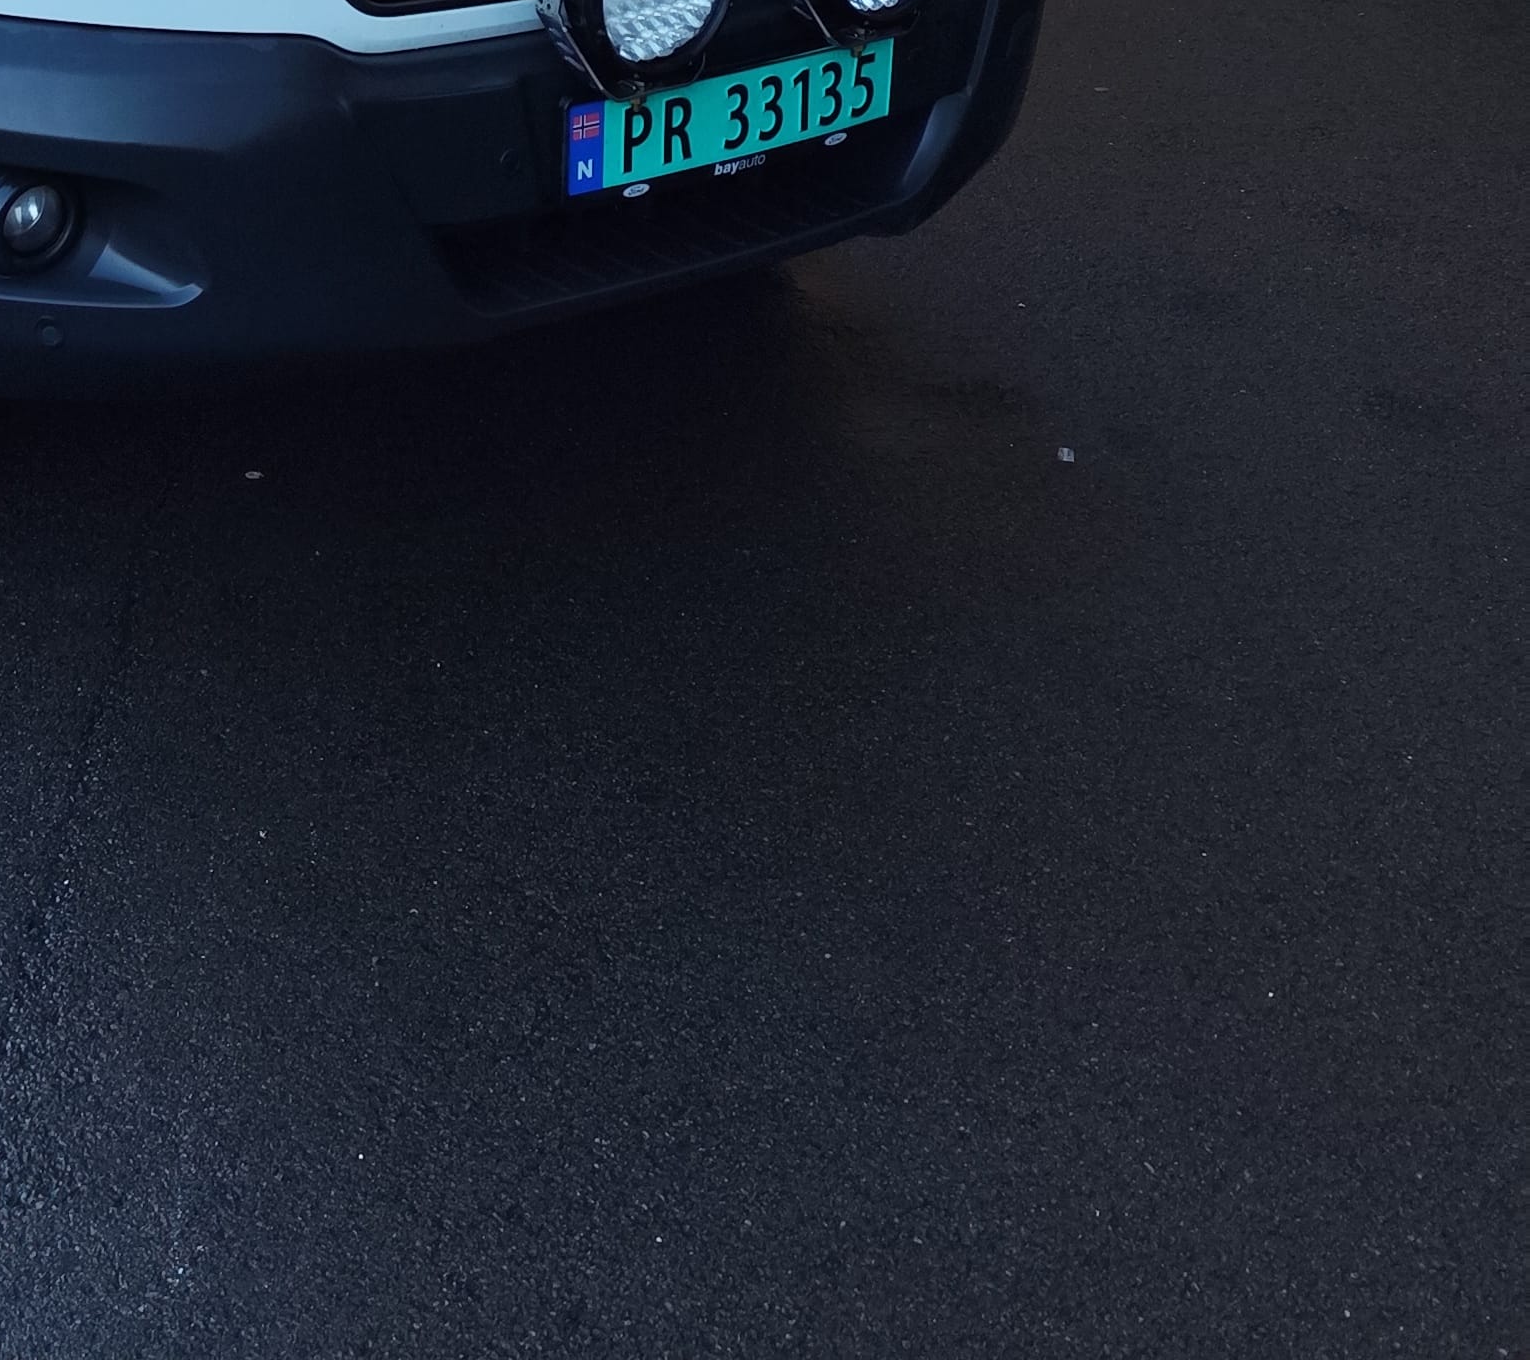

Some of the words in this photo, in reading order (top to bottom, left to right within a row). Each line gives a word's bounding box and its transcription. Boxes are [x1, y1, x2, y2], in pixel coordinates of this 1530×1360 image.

[623, 96, 693, 175] PR
[723, 52, 876, 150] 33135
[577, 159, 593, 180] N
[714, 153, 766, 176] bayauto
